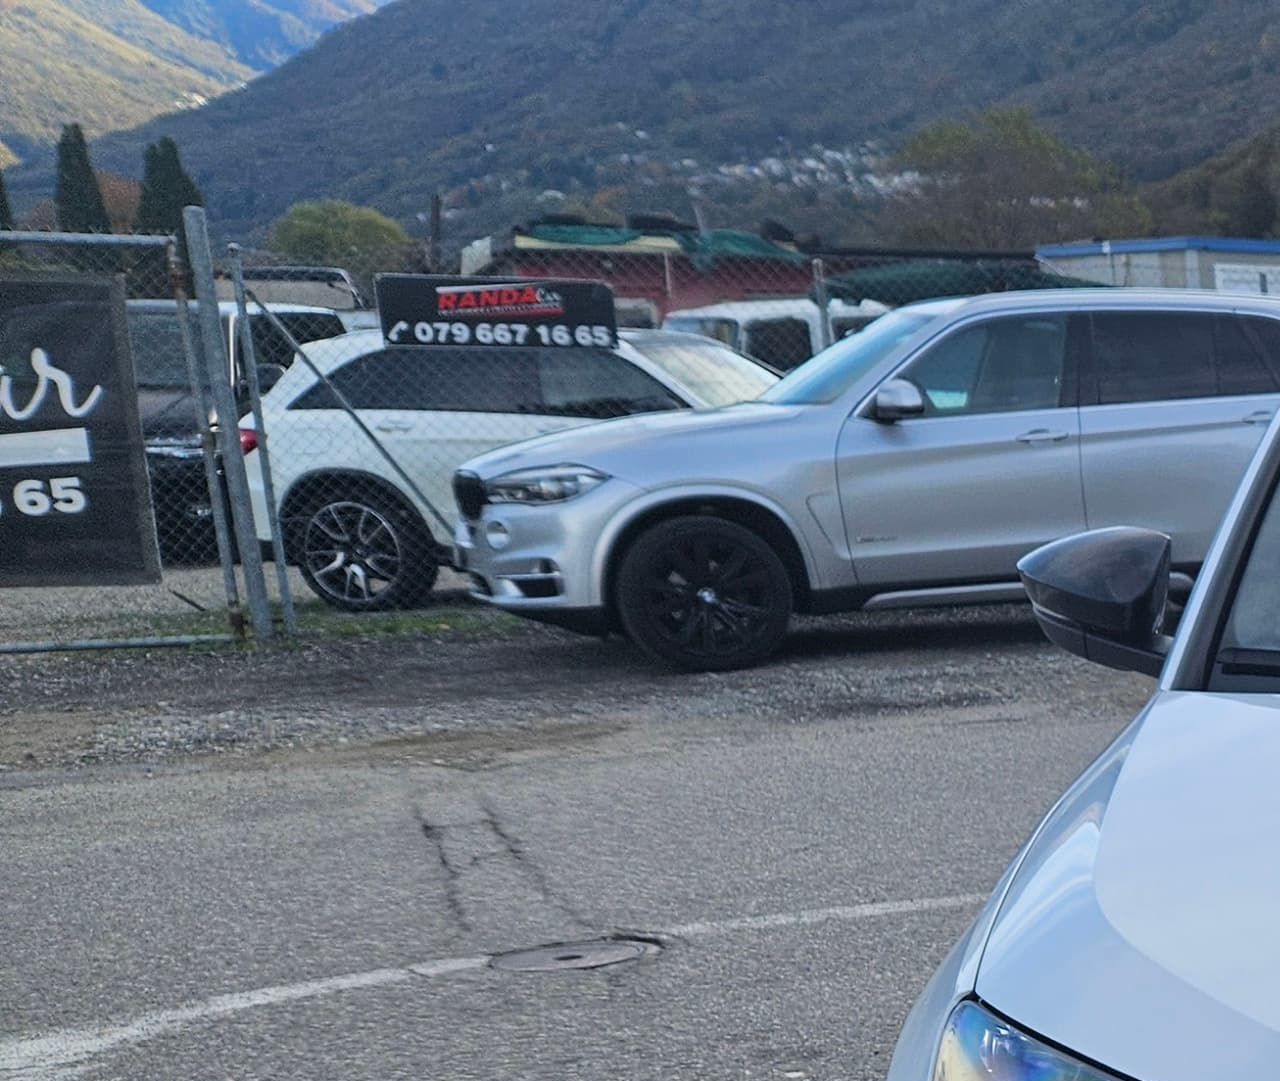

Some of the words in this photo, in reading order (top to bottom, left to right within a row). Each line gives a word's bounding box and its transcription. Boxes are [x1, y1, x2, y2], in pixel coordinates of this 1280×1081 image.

[437, 286, 538, 311] RANDA
[414, 321, 471, 344] 079
[475, 322, 530, 346] 667
[535, 323, 573, 347] 16
[574, 324, 613, 348] 65
[13, 475, 87, 517] 65
